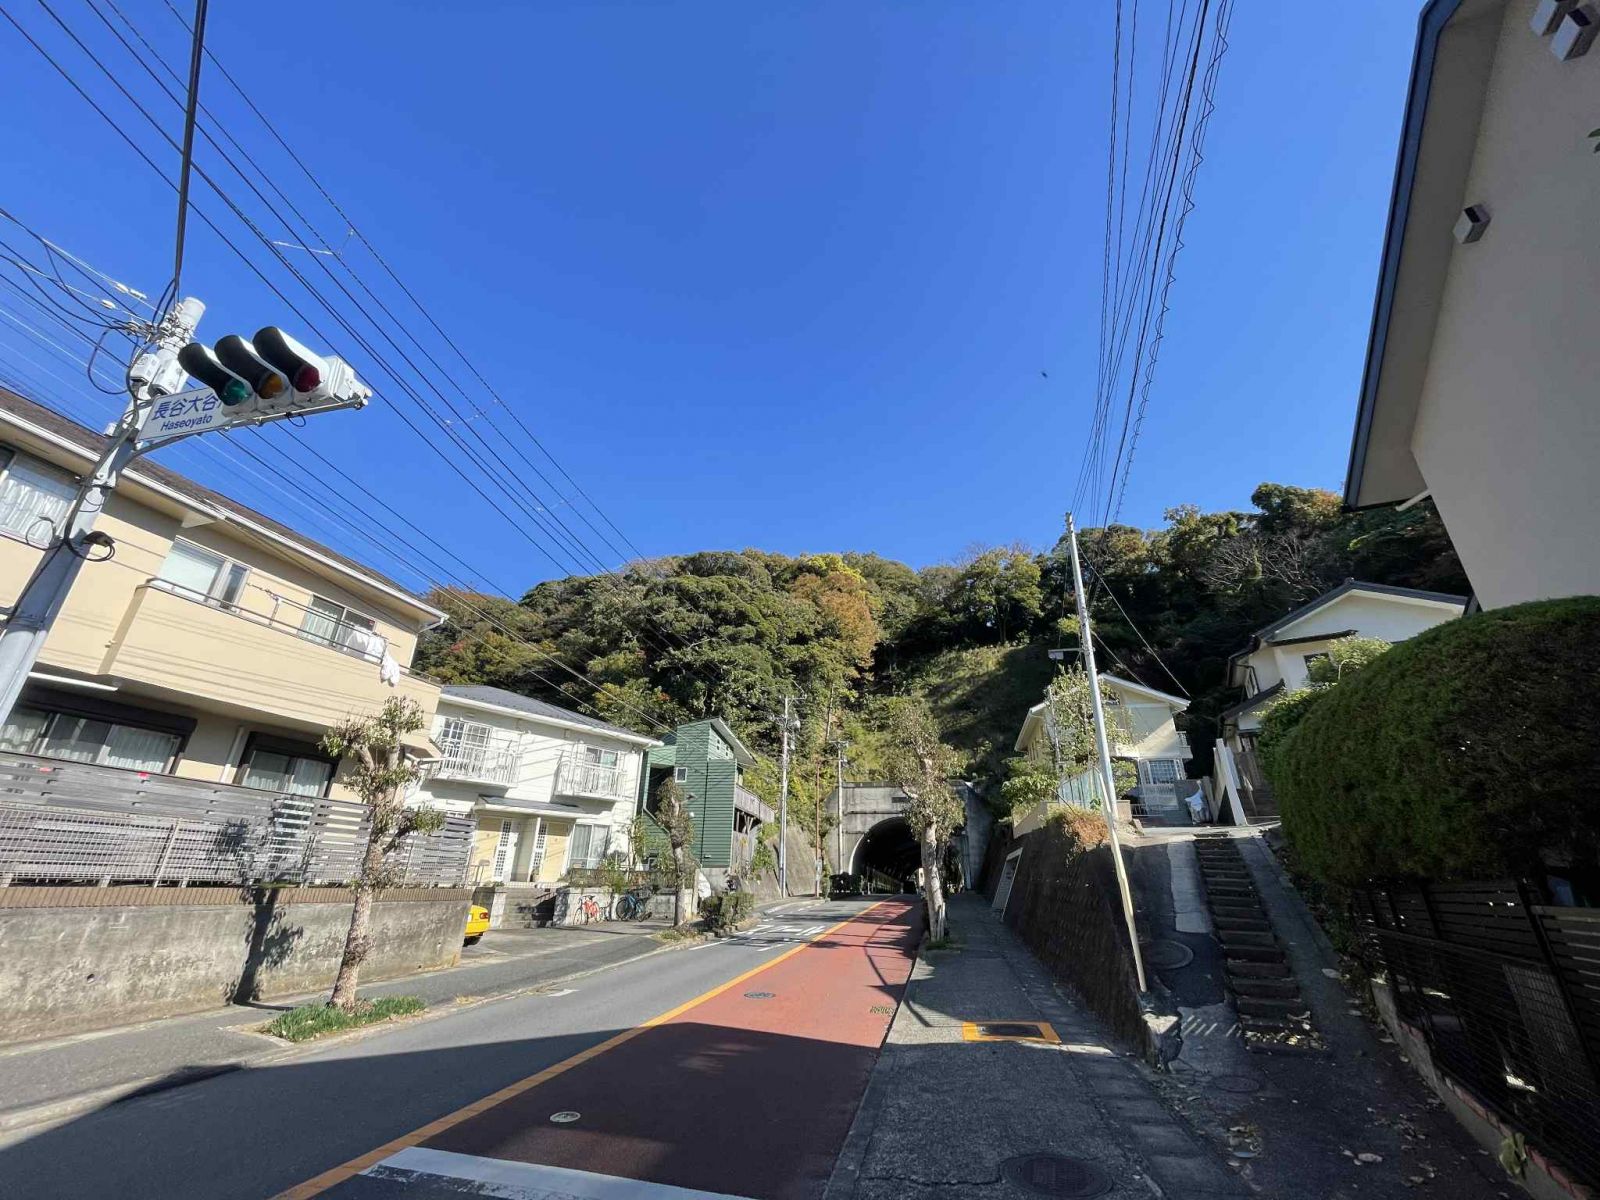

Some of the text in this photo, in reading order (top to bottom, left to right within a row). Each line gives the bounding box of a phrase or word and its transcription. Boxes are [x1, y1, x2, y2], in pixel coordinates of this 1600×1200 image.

[152, 393, 221, 420] 長谷大谷
[160, 414, 213, 431] Haseoyato
